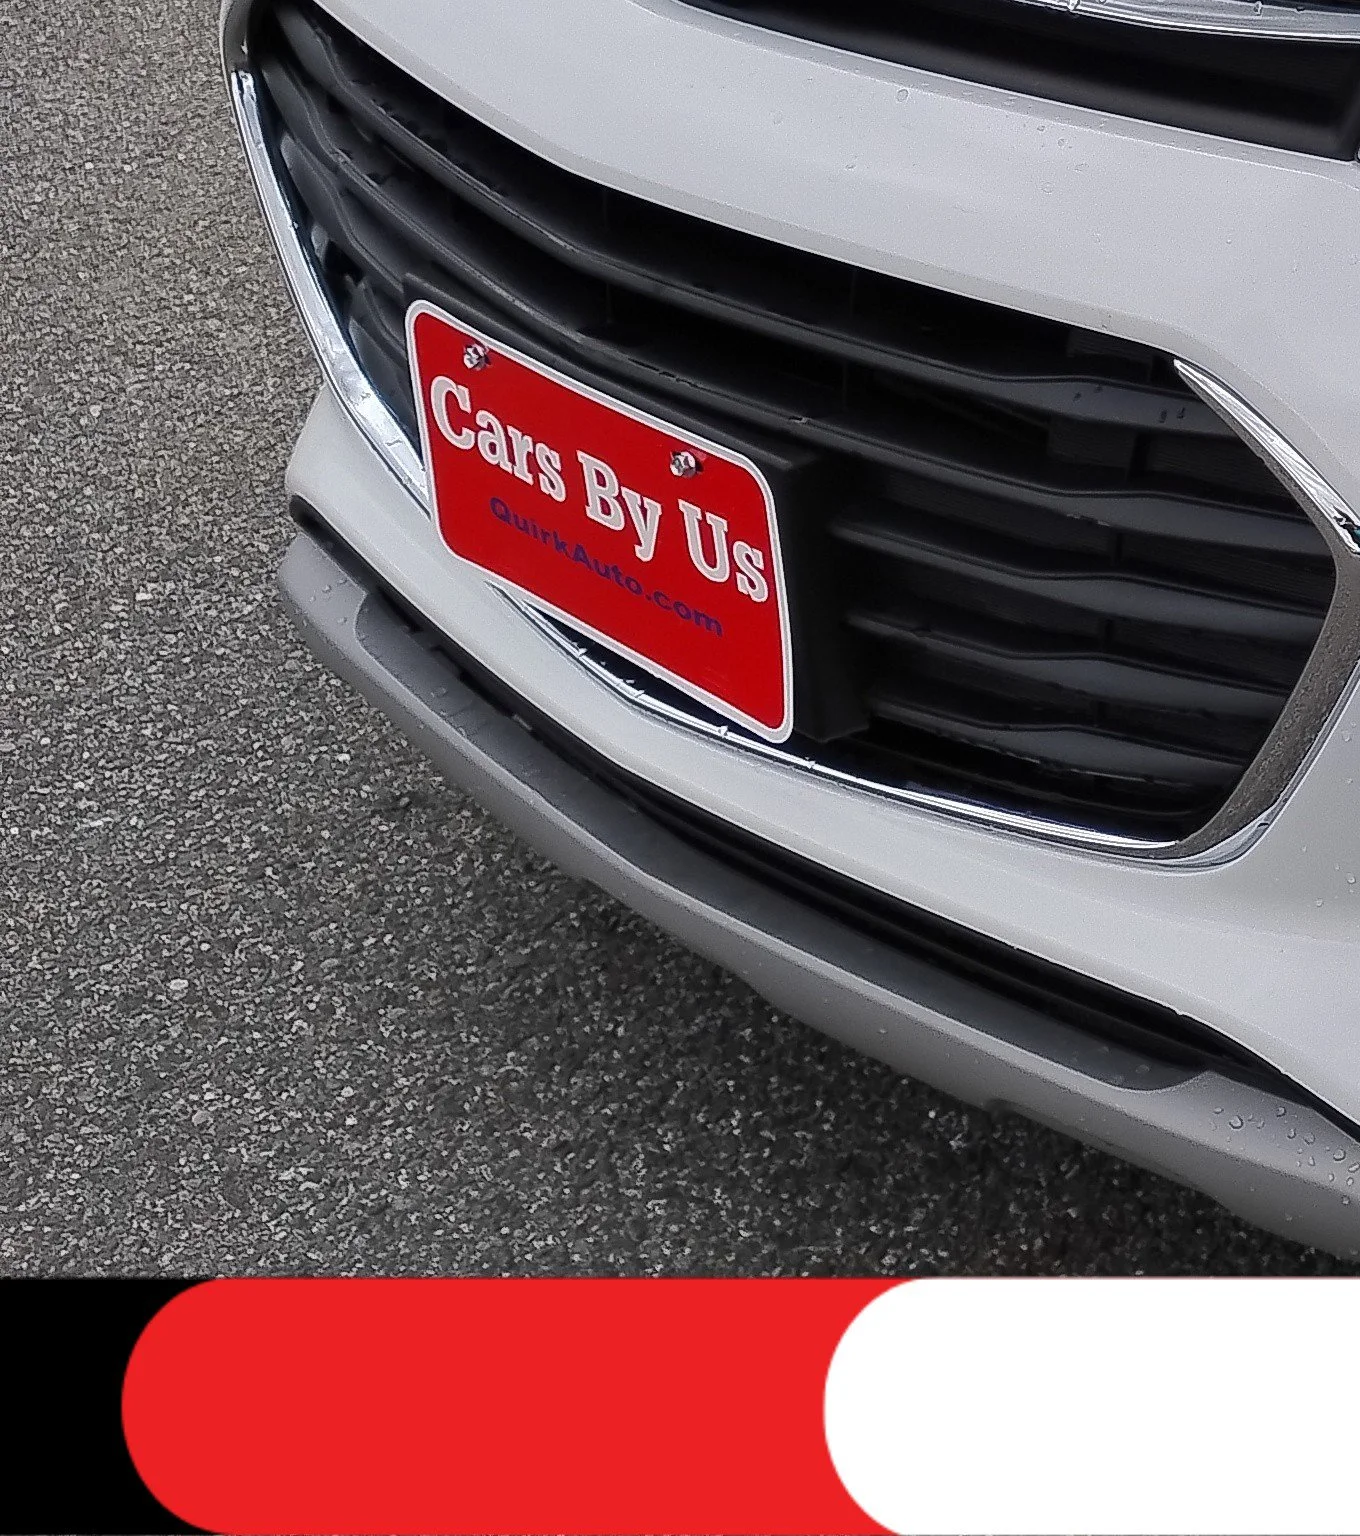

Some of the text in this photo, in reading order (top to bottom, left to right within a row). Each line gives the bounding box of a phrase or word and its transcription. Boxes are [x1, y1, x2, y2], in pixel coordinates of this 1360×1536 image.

[429, 375, 769, 603] Cars By Us
[490, 497, 722, 636] QuirkAuto.com
